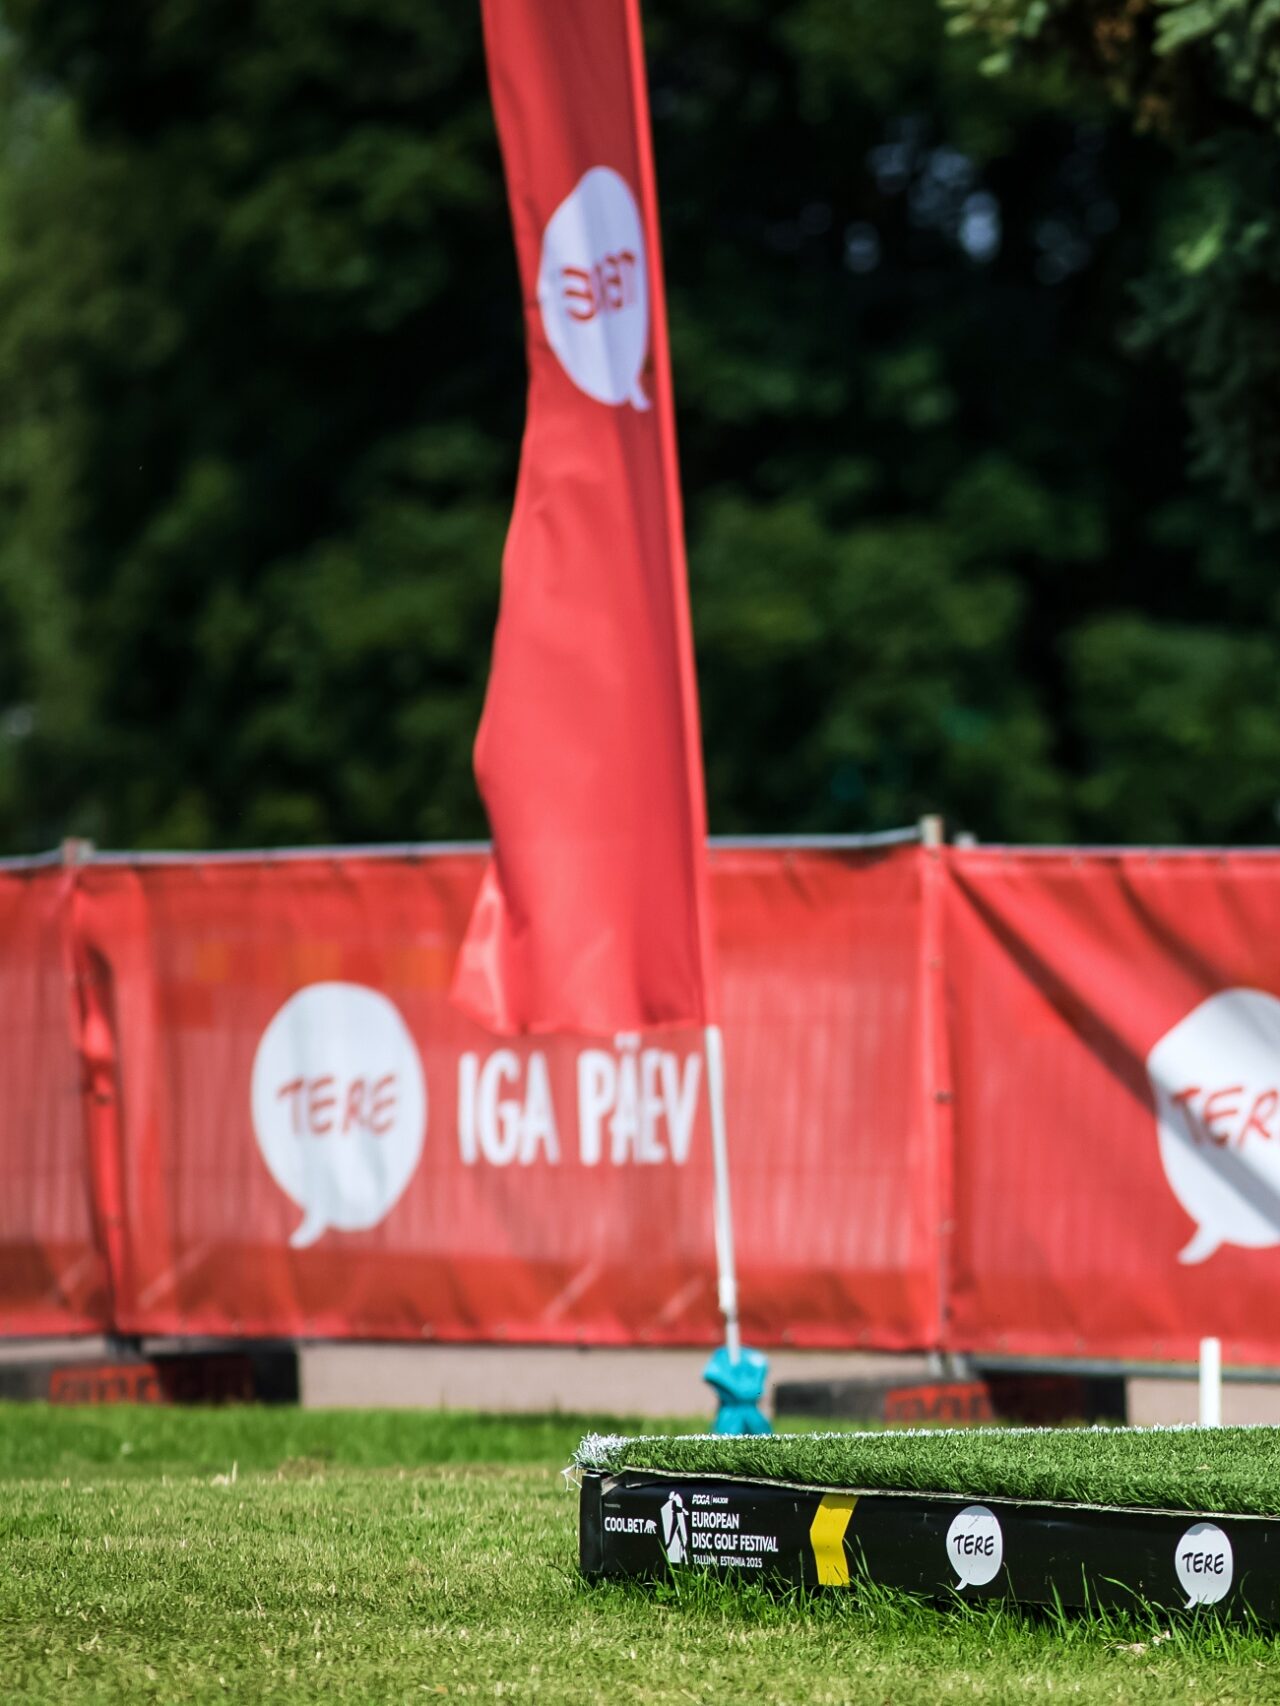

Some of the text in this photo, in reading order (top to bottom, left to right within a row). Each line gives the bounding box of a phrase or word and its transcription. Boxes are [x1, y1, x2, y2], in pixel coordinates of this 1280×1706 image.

[277, 1073, 400, 1138] TERE
[457, 1031, 702, 1167] IGA PÄEV
[692, 1494, 710, 1505] PDGA
[604, 1516, 644, 1534] COOLBET
[691, 1511, 739, 1530] EUROPEAN
[691, 1533, 778, 1553] DISC GOLF FESTIVAL
[953, 1534, 994, 1557] TERE
[720, 1556, 746, 1567] ESTONIA
[746, 1557, 763, 1568] 2025
[1182, 1551, 1225, 1575] TERE
